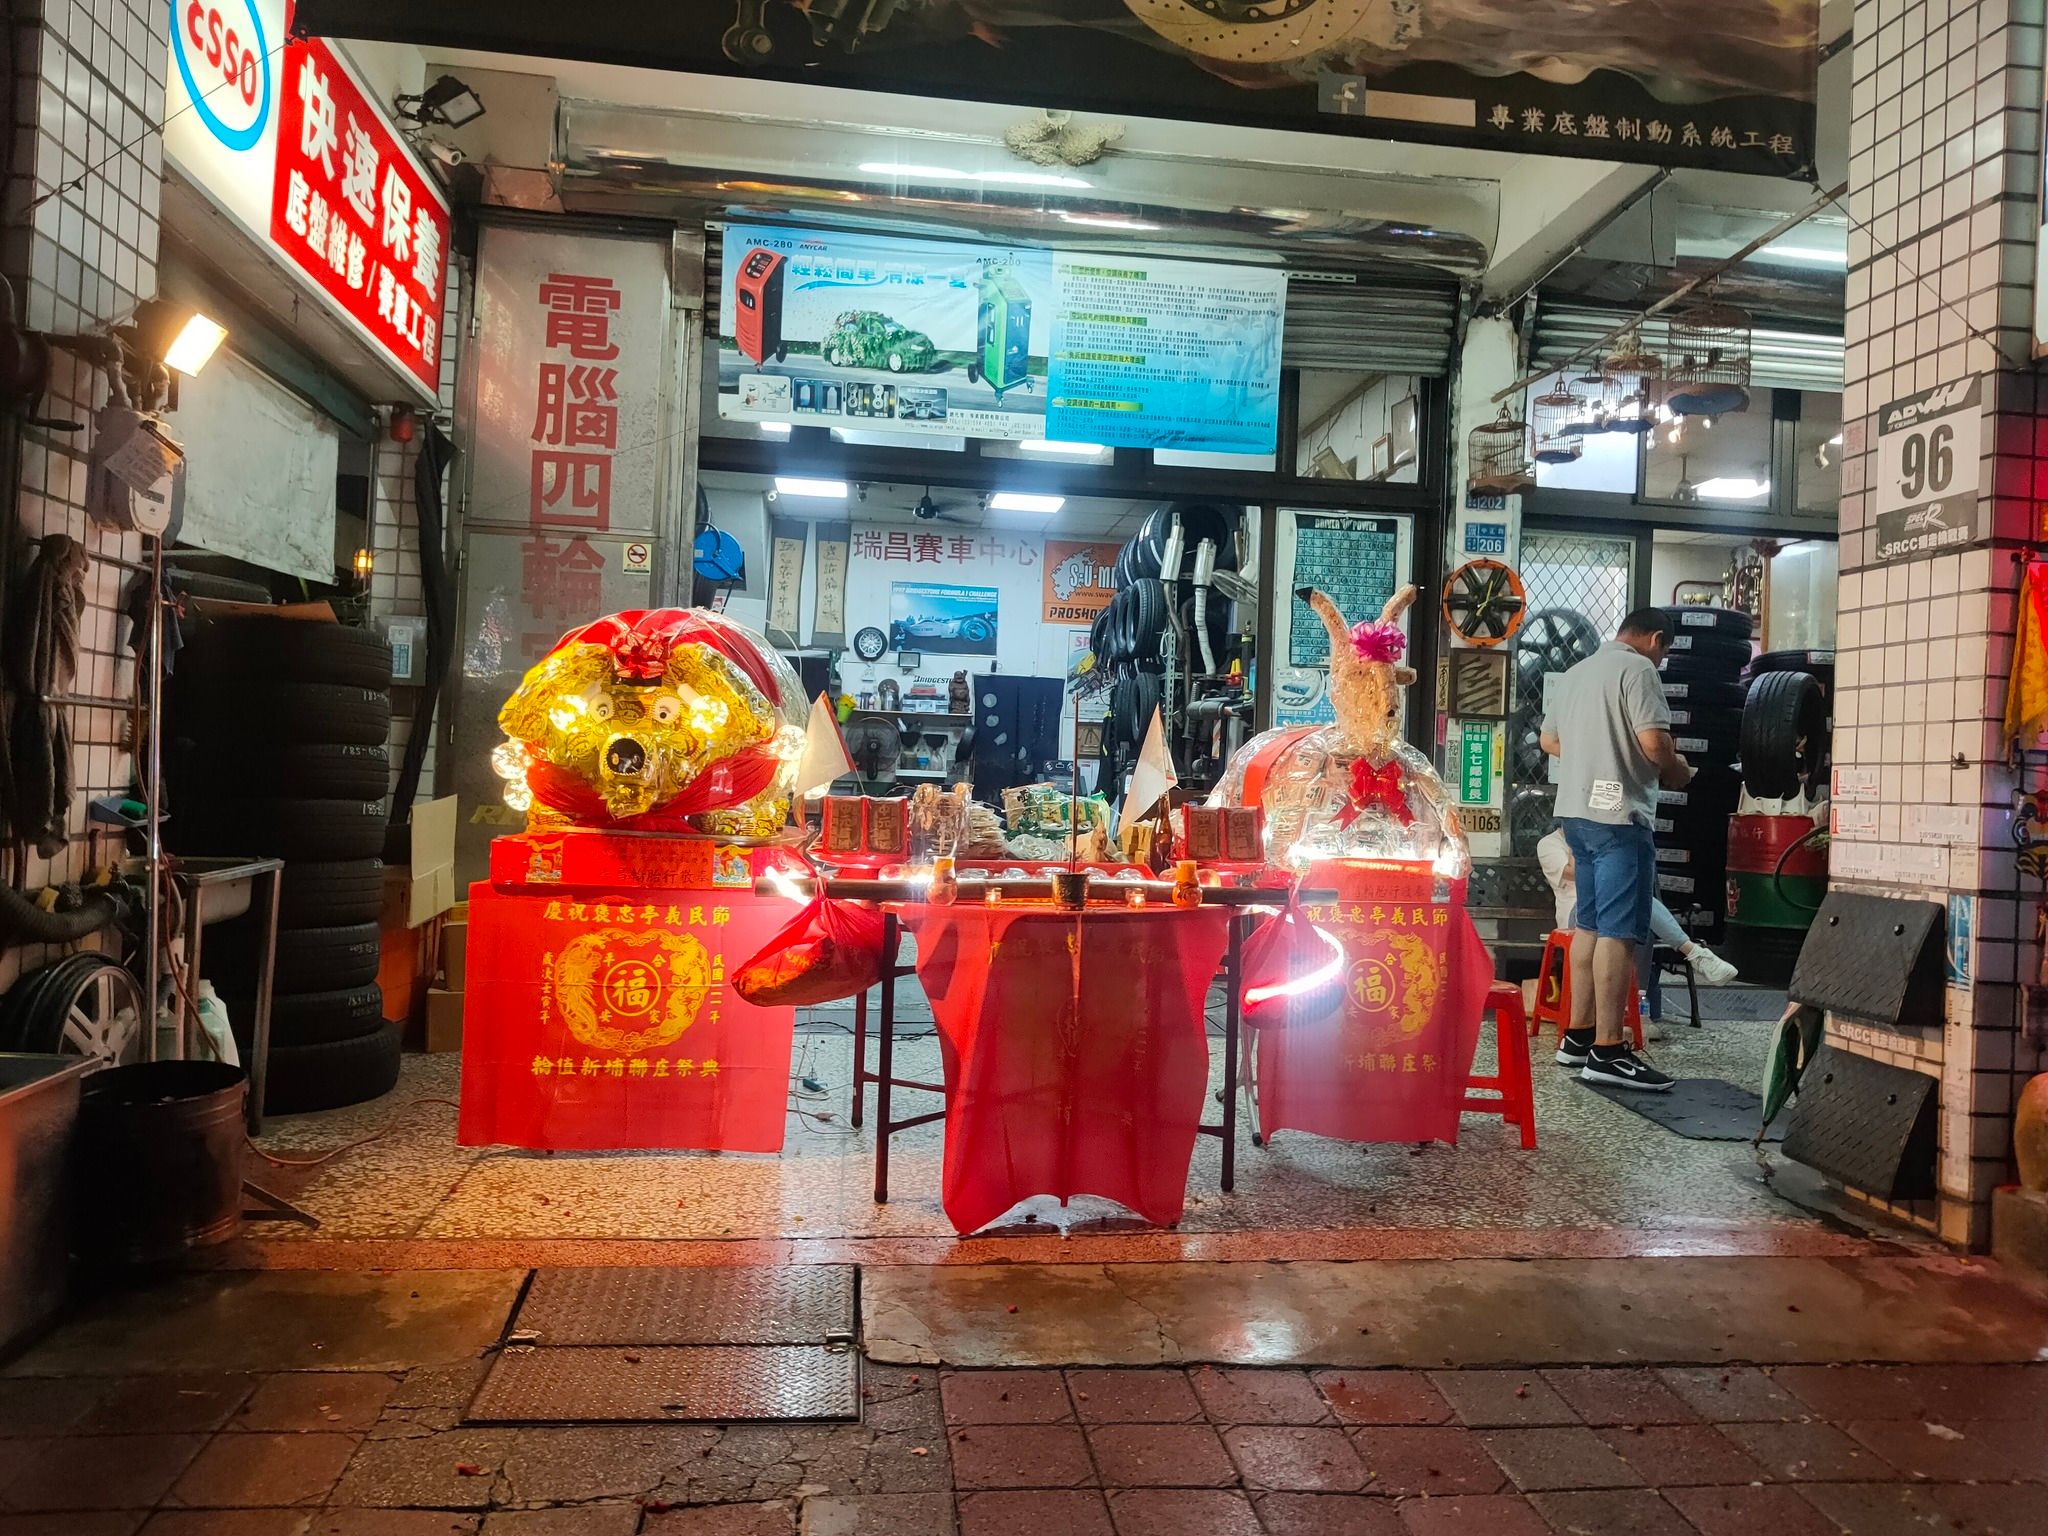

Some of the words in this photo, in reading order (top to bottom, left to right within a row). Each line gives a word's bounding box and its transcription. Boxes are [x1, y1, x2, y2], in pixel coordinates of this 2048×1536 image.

[1486, 103, 1797, 155] 專業底盤制動系統工程
[297, 52, 441, 302] 快速保養
[1901, 424, 1954, 500] 96
[1480, 495, 1504, 510] 202
[853, 530, 1038, 567] 瑞昌賽車中心
[1480, 538, 1502, 552] 206
[611, 967, 651, 1008] 福
[1353, 965, 1388, 1005] 福
